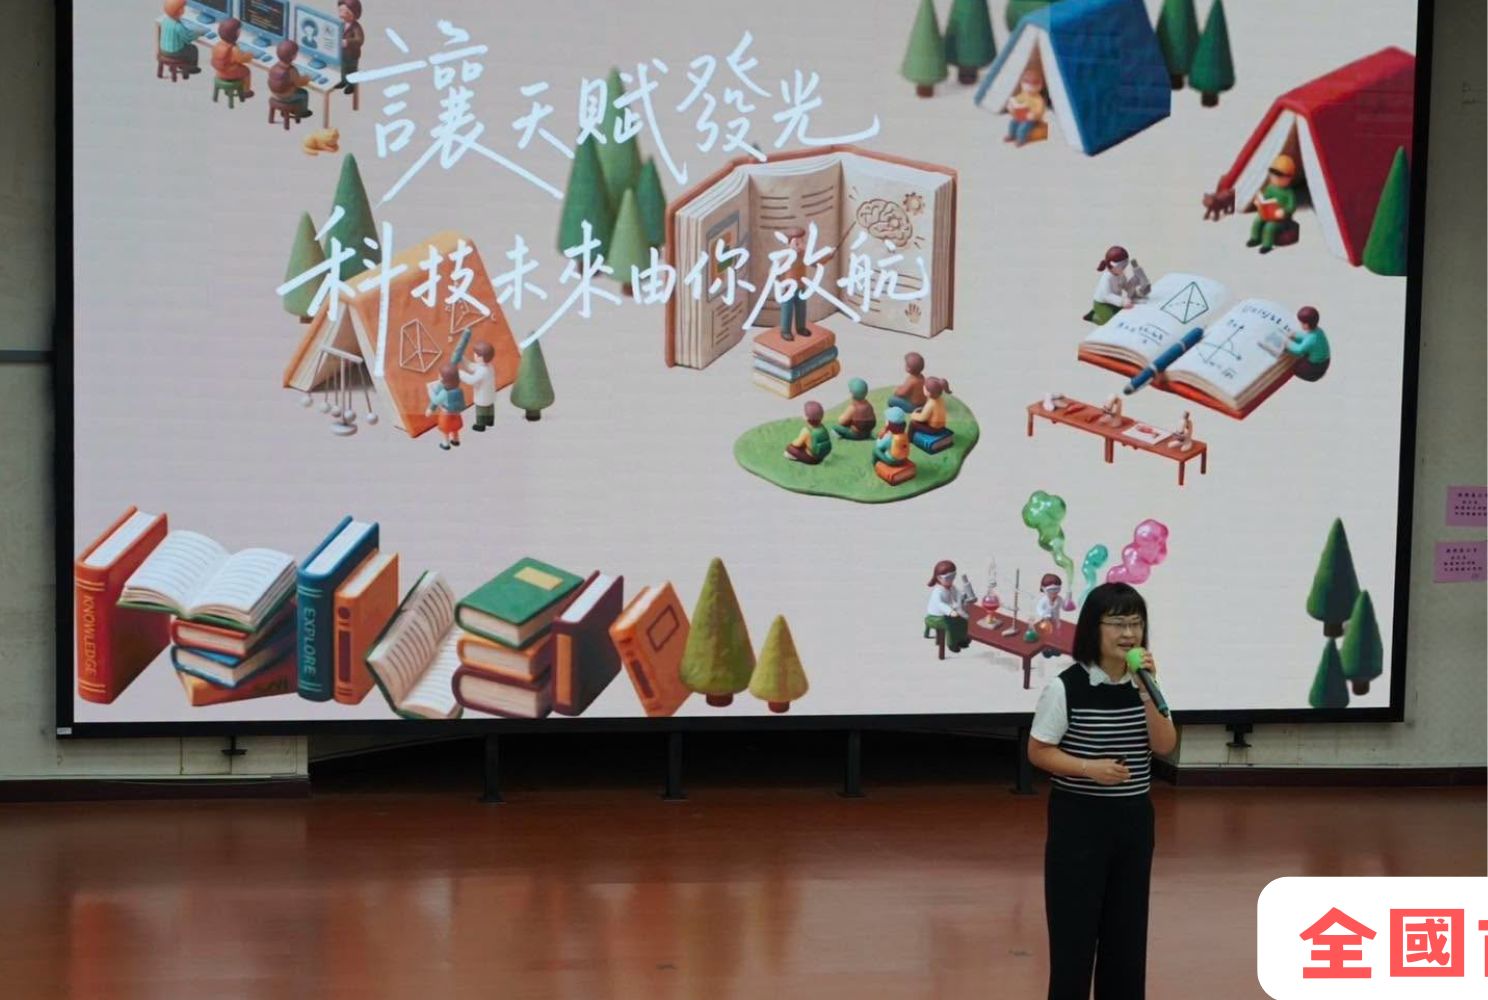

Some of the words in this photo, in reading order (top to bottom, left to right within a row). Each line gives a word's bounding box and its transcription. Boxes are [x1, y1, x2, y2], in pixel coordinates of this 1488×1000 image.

[346, 20, 881, 206] 讓天賦發光
[82, 594, 97, 680] KNOWLEDGE
[303, 607, 316, 675] EXPLORE
